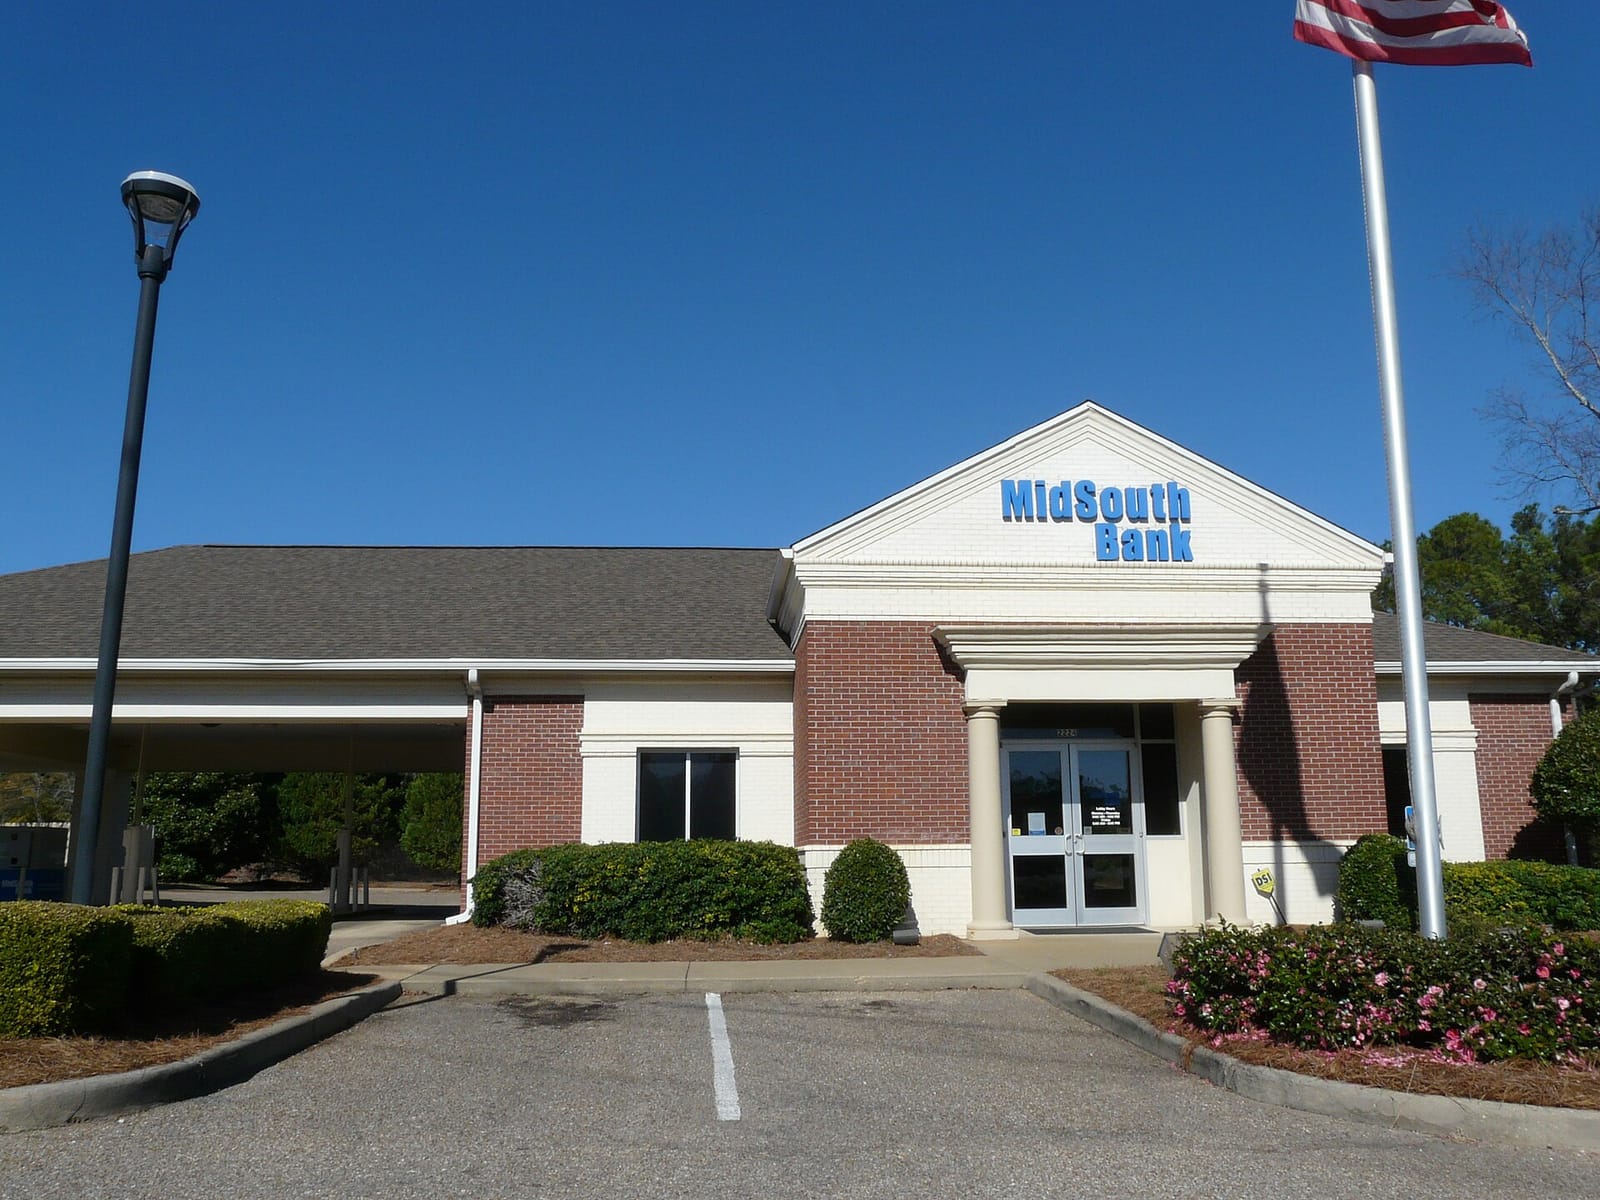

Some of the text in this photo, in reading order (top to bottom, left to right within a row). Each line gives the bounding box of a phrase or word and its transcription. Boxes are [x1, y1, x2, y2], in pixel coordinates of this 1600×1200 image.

[1000, 479, 1192, 523] MidSouth
[1094, 523, 1194, 562] Bank
[1255, 872, 1273, 886] DSI
